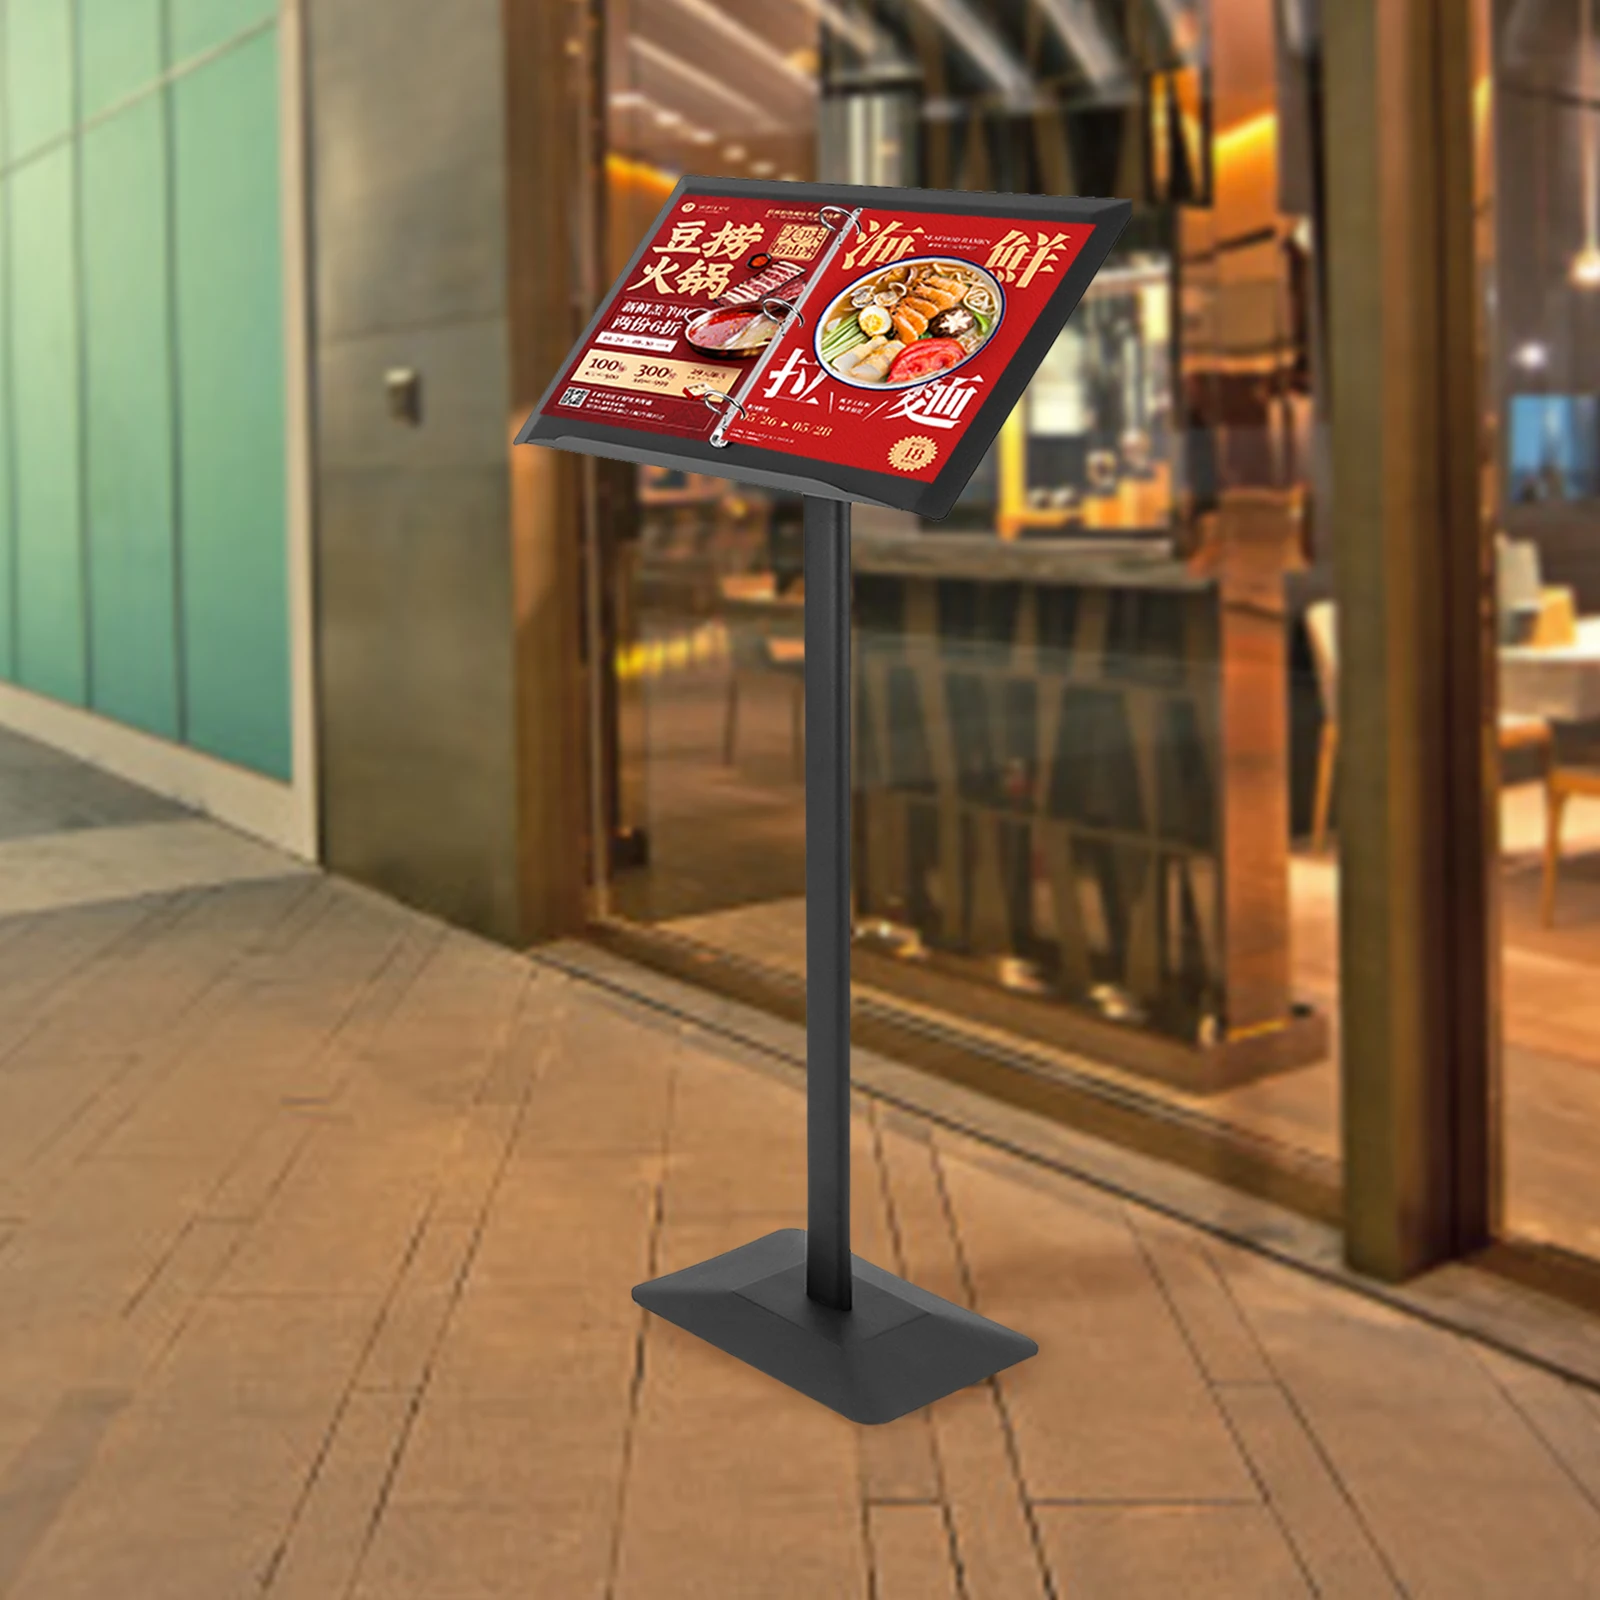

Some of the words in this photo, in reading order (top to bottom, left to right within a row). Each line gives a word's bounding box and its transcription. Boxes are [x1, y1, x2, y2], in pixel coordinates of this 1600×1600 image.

[652, 220, 764, 261] 豆捞
[842, 220, 925, 270] 海
[626, 256, 735, 300] 火锅
[611, 315, 683, 336] 两份6折
[762, 348, 828, 405] 拉
